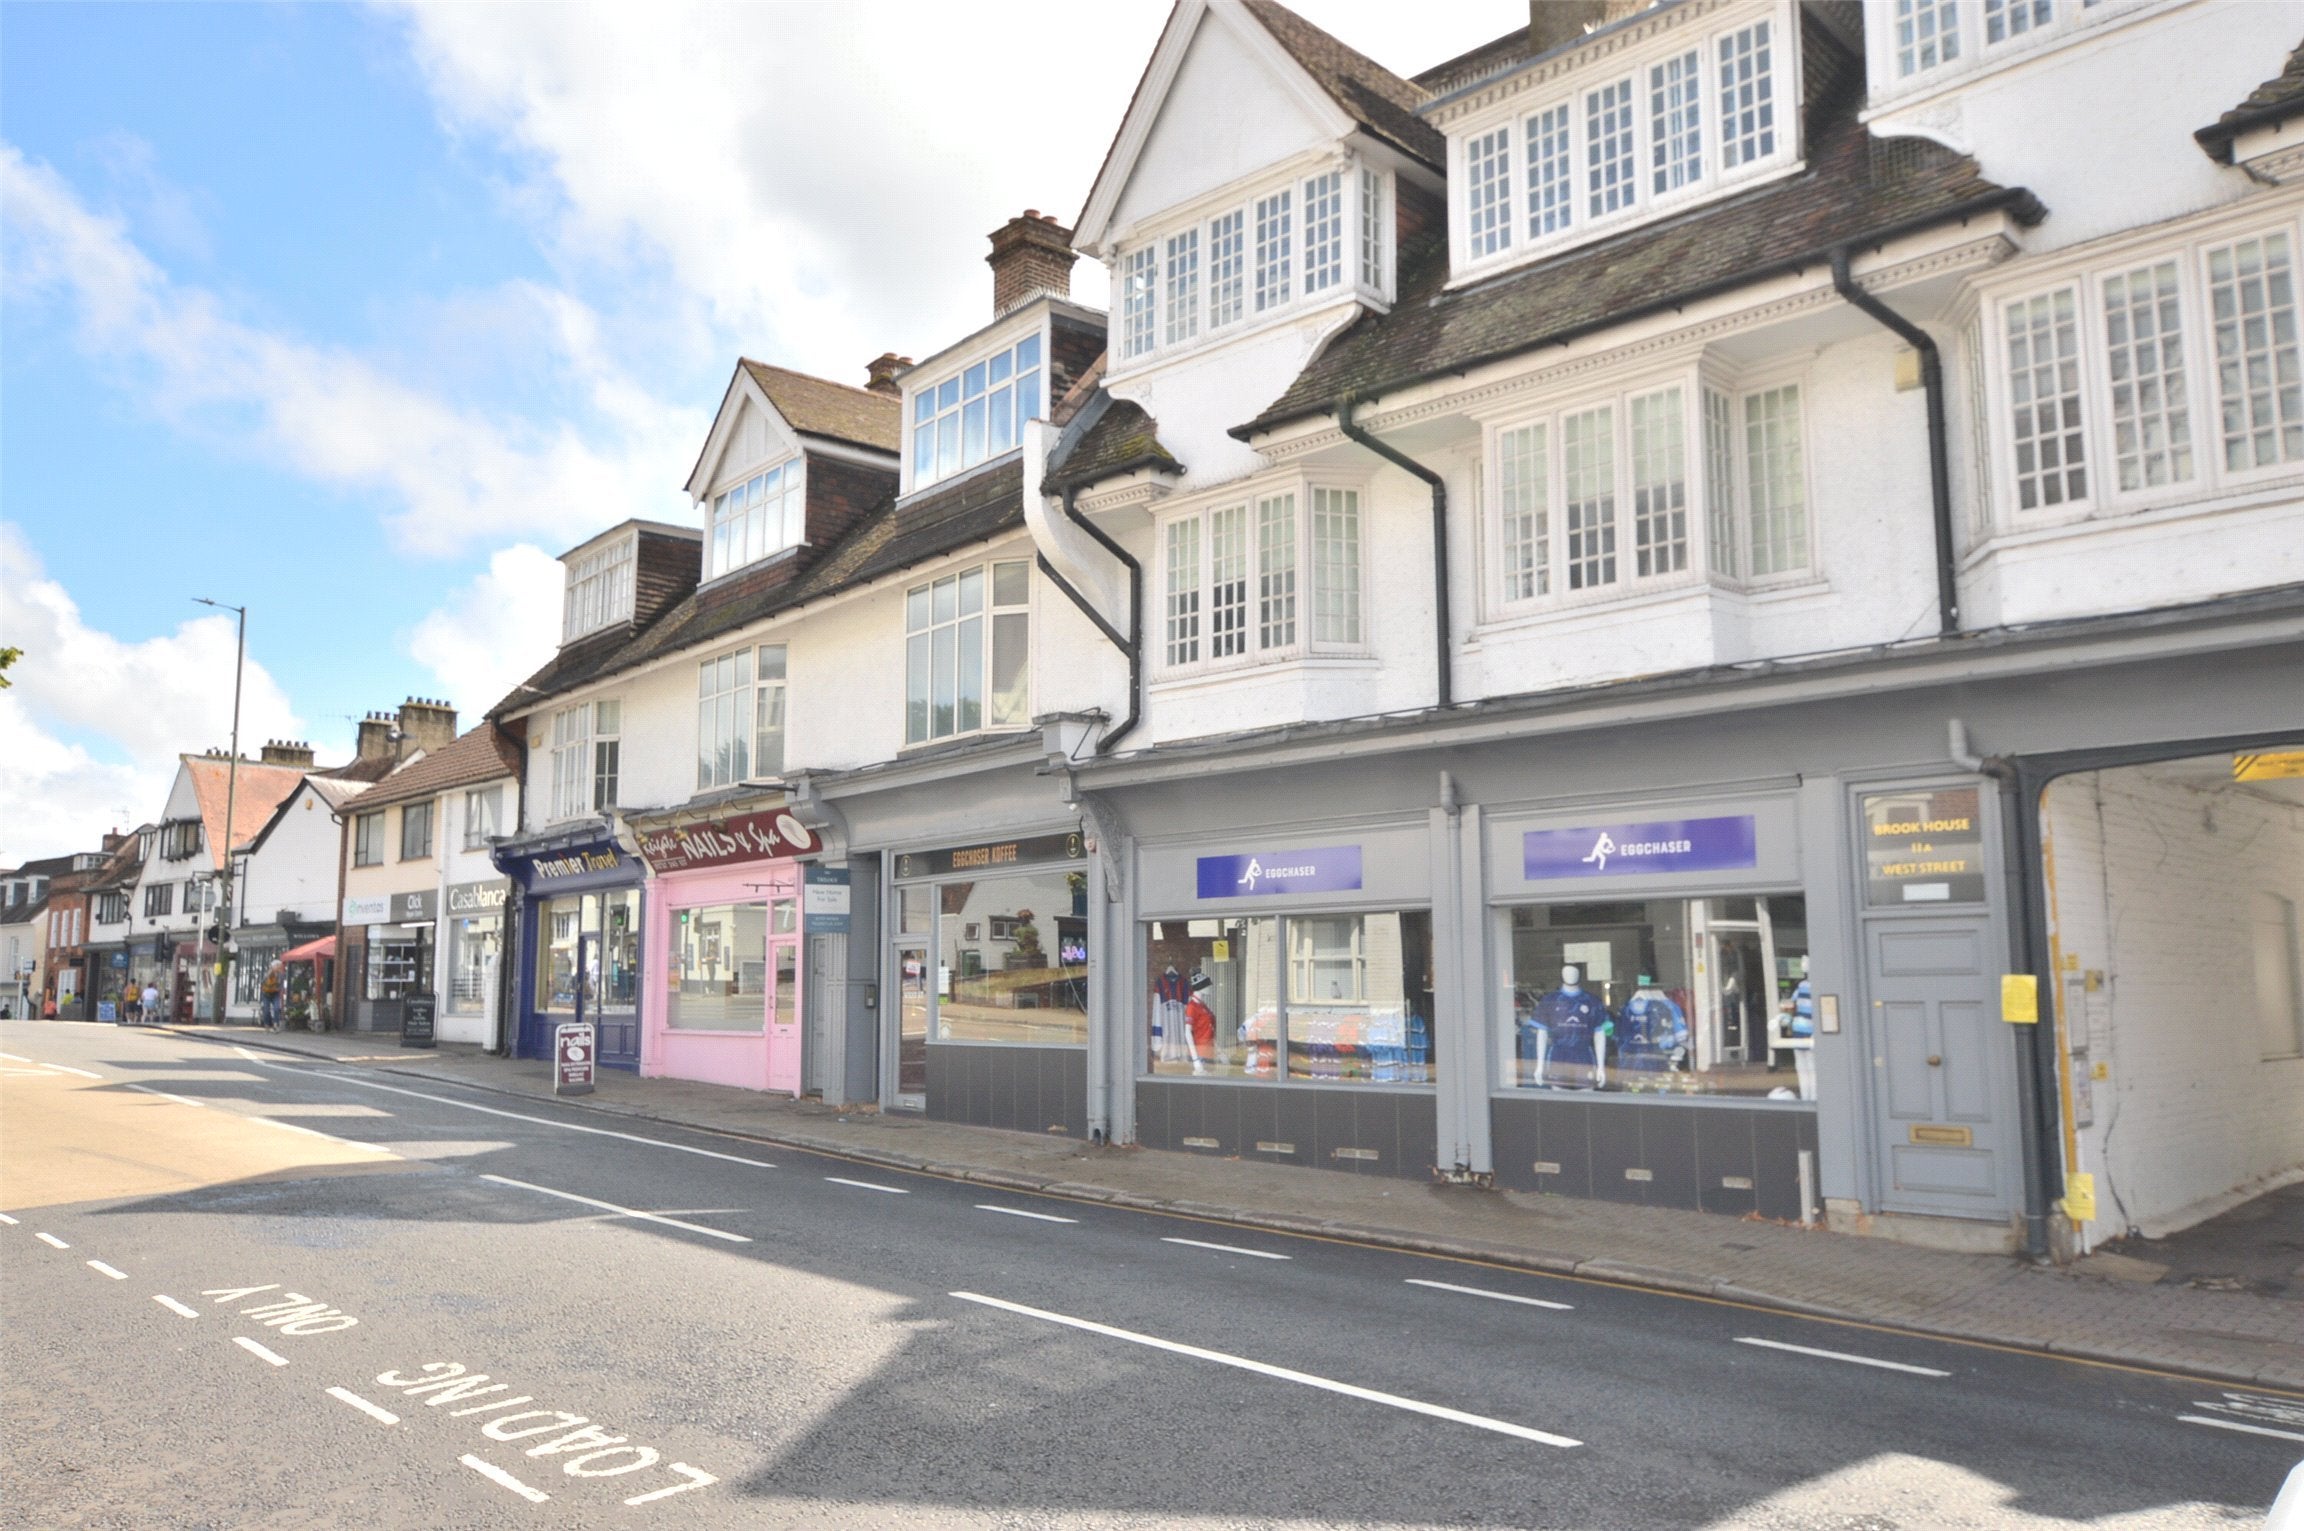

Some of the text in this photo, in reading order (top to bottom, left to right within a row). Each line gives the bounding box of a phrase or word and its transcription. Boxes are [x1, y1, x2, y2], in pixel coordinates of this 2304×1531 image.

[1874, 819, 1970, 836] BROOK HOUSE
[681, 831, 736, 860] NAILS
[734, 831, 751, 853] &
[748, 821, 781, 857] Spa
[1620, 839, 1692, 857] EGGCHASER
[532, 847, 618, 879] Premier Travel
[952, 844, 1017, 868] EGGCHASER KOFFEE
[1265, 865, 1316, 879] EGGCHASER
[1882, 860, 1967, 876] WEST STREET
[450, 884, 506, 911] Casablanca
[560, 1032, 591, 1048] nails
[201, 1284, 720, 1505] LOADING ONLY
